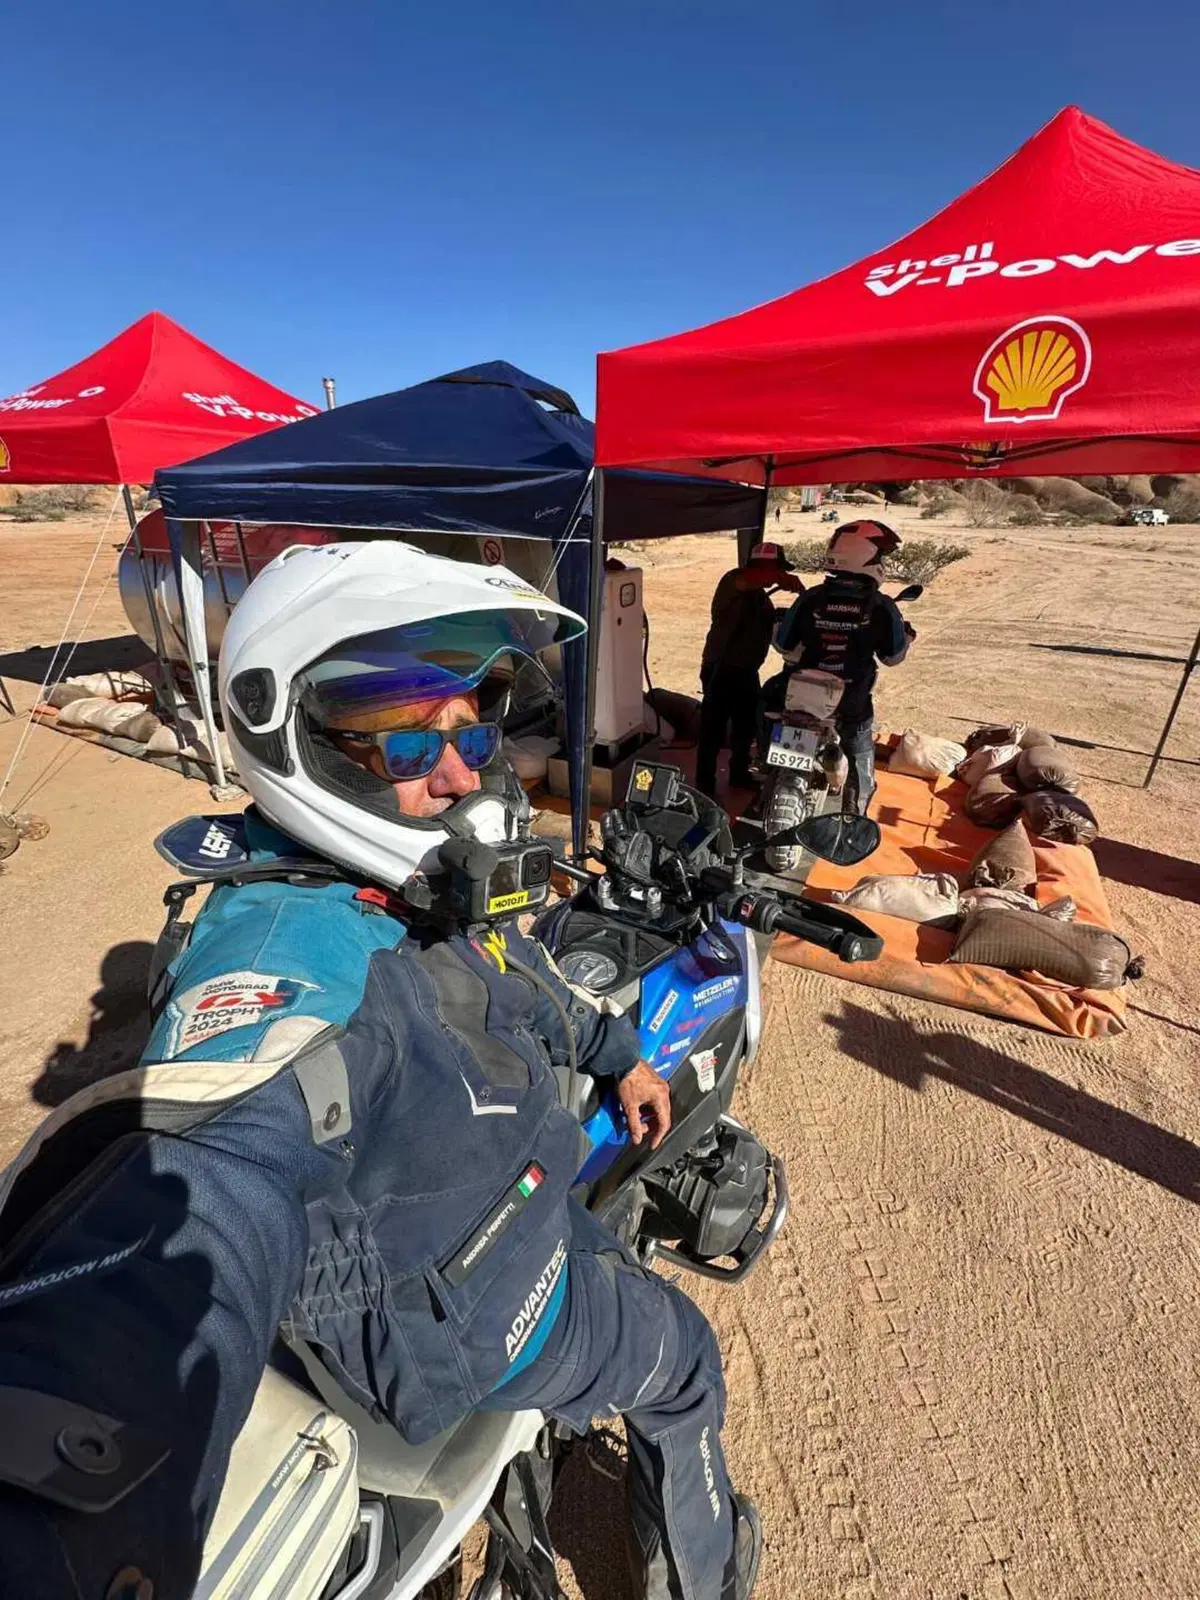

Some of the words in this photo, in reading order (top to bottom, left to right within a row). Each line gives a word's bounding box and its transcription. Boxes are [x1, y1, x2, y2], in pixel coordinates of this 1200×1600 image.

[864, 239, 1200, 297] V-Powe
[865, 242, 994, 280] Shell
[182, 392, 239, 407] Shell
[196, 402, 305, 424] V-Pow
[793, 729, 802, 741] M
[770, 752, 787, 765] GS
[788, 755, 811, 769] 971
[202, 984, 269, 996] MOTORRAD
[191, 1007, 262, 1023] TROPHY
[185, 1017, 233, 1035] 2024
[462, 1235, 489, 1269] ANDREA
[486, 1202, 516, 1237] PERFETTI
[505, 1238, 564, 1357] ADVANTEC
